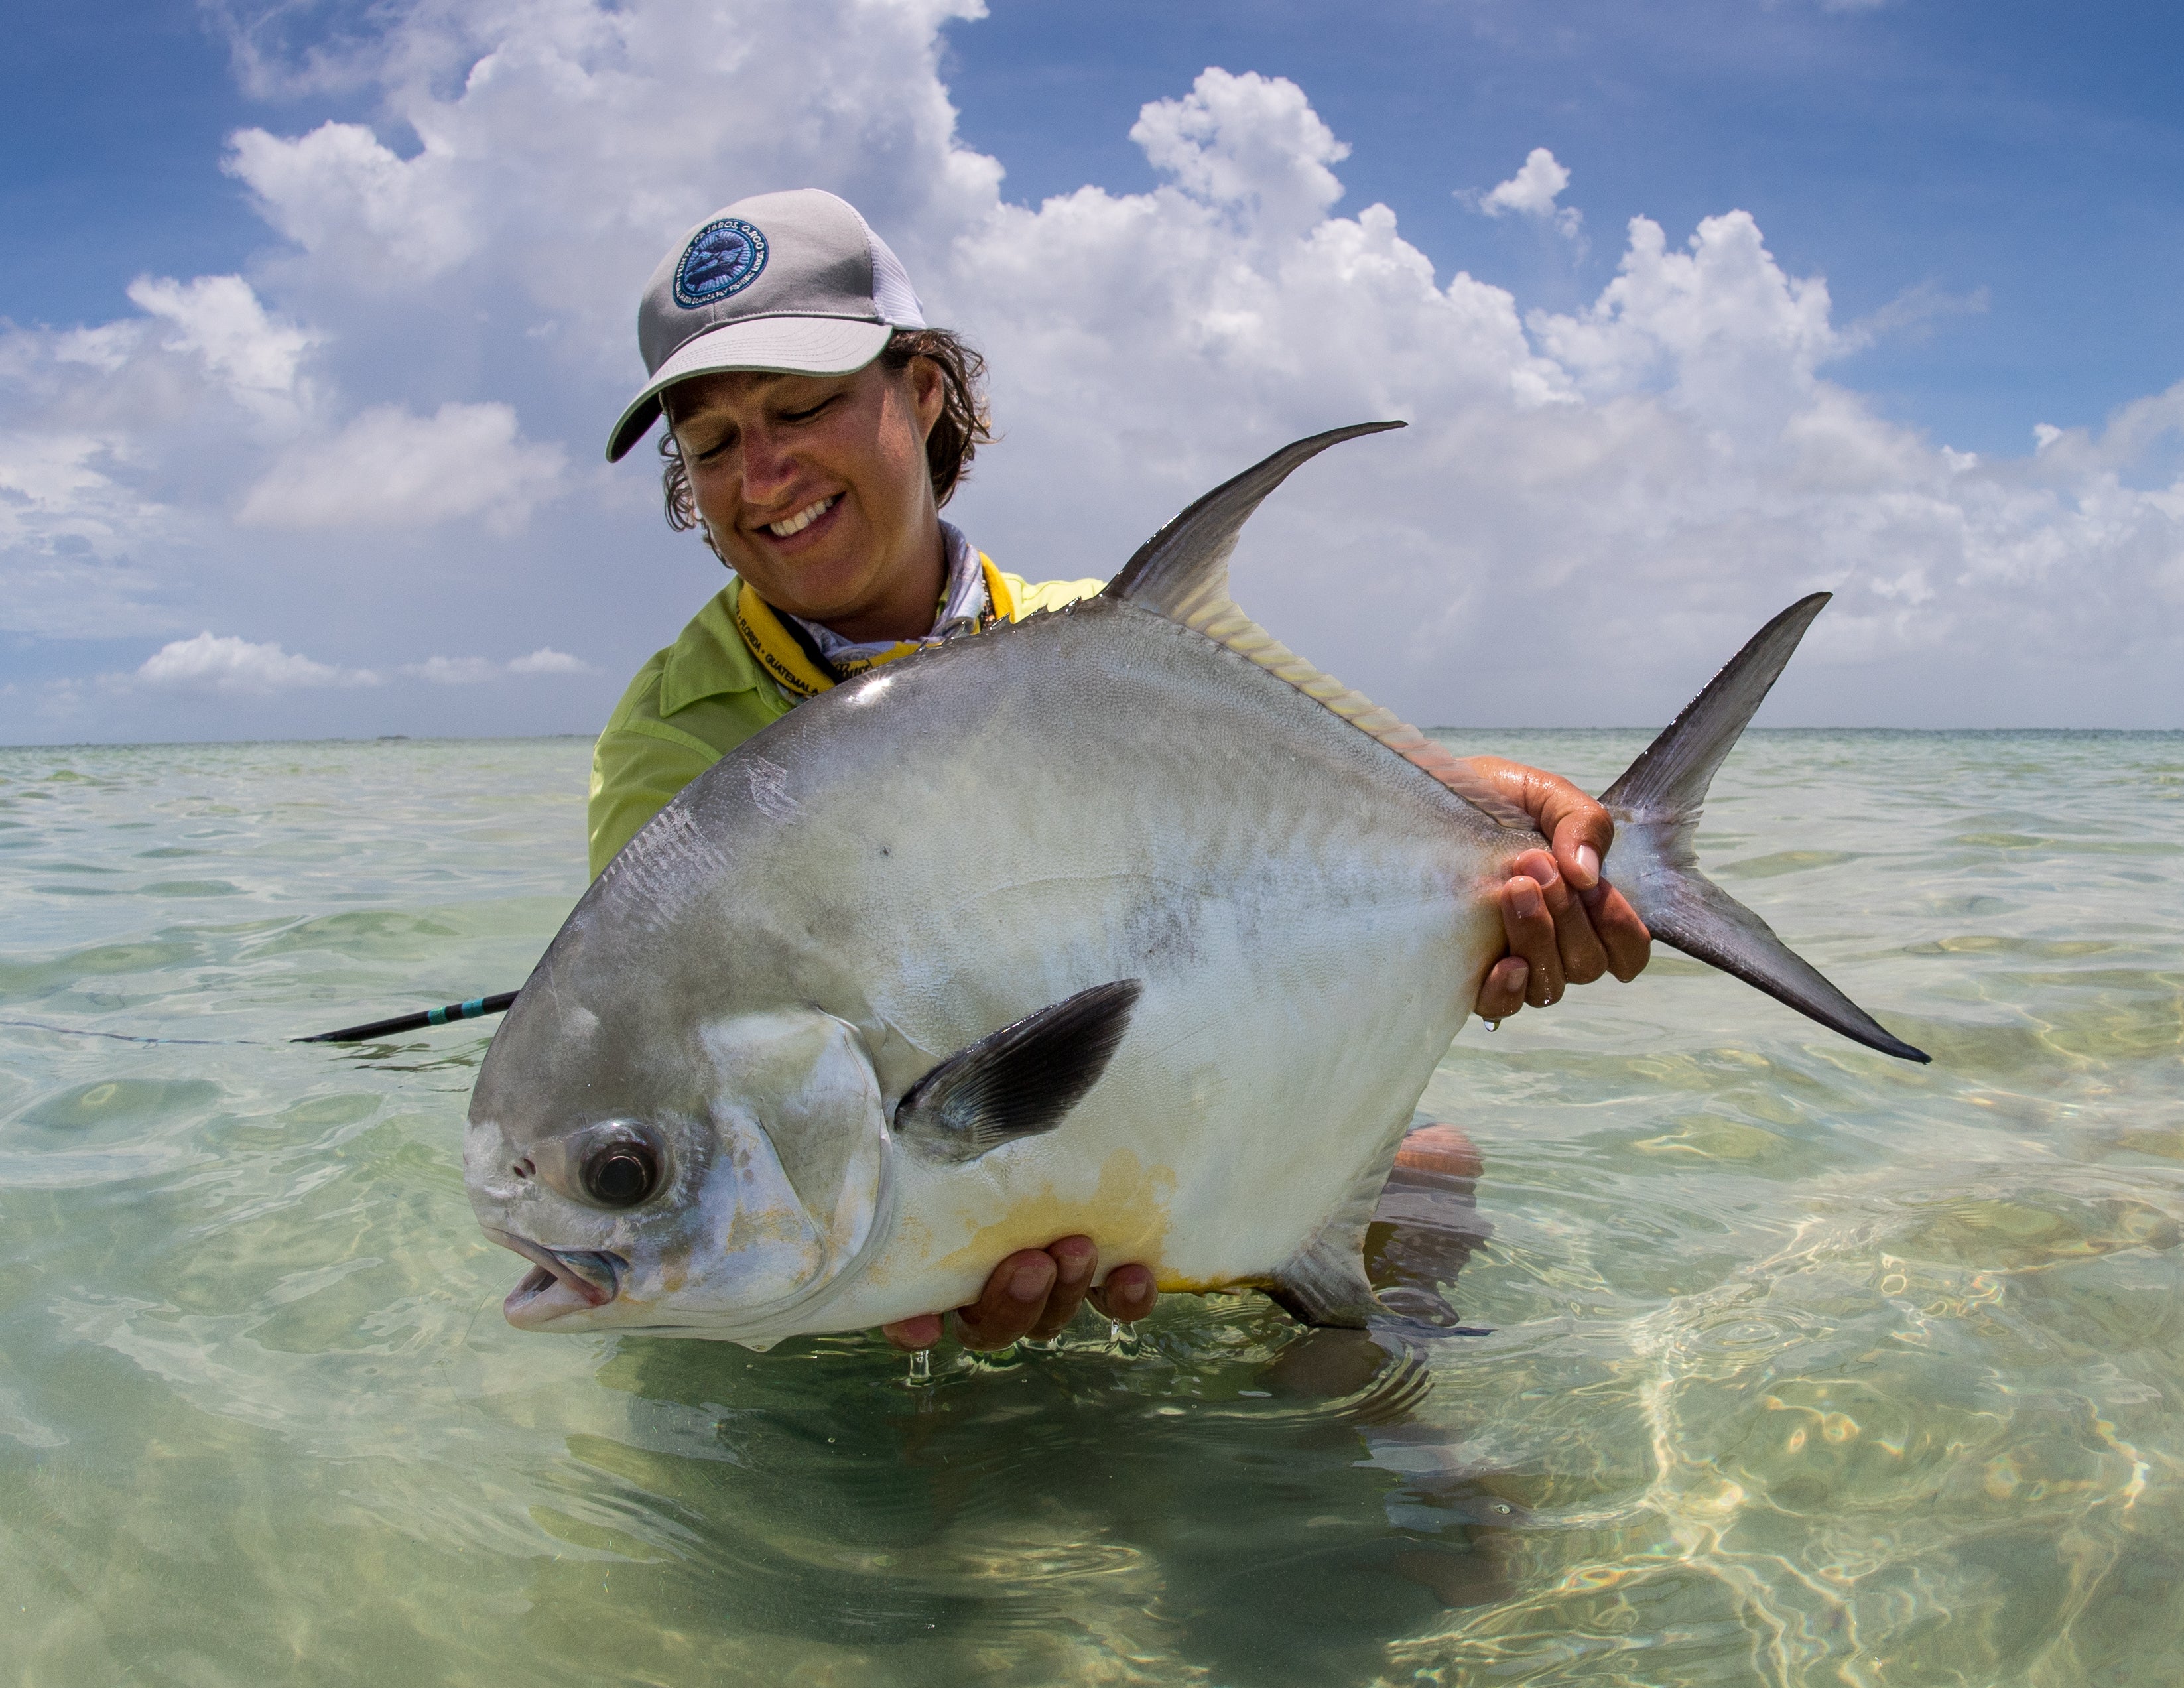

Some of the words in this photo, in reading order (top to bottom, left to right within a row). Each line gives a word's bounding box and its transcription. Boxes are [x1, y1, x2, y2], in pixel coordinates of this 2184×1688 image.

[729, 271, 755, 291] FISHING
[739, 619, 761, 652] FLORIDA
[765, 653, 819, 696] GUATEMALA
